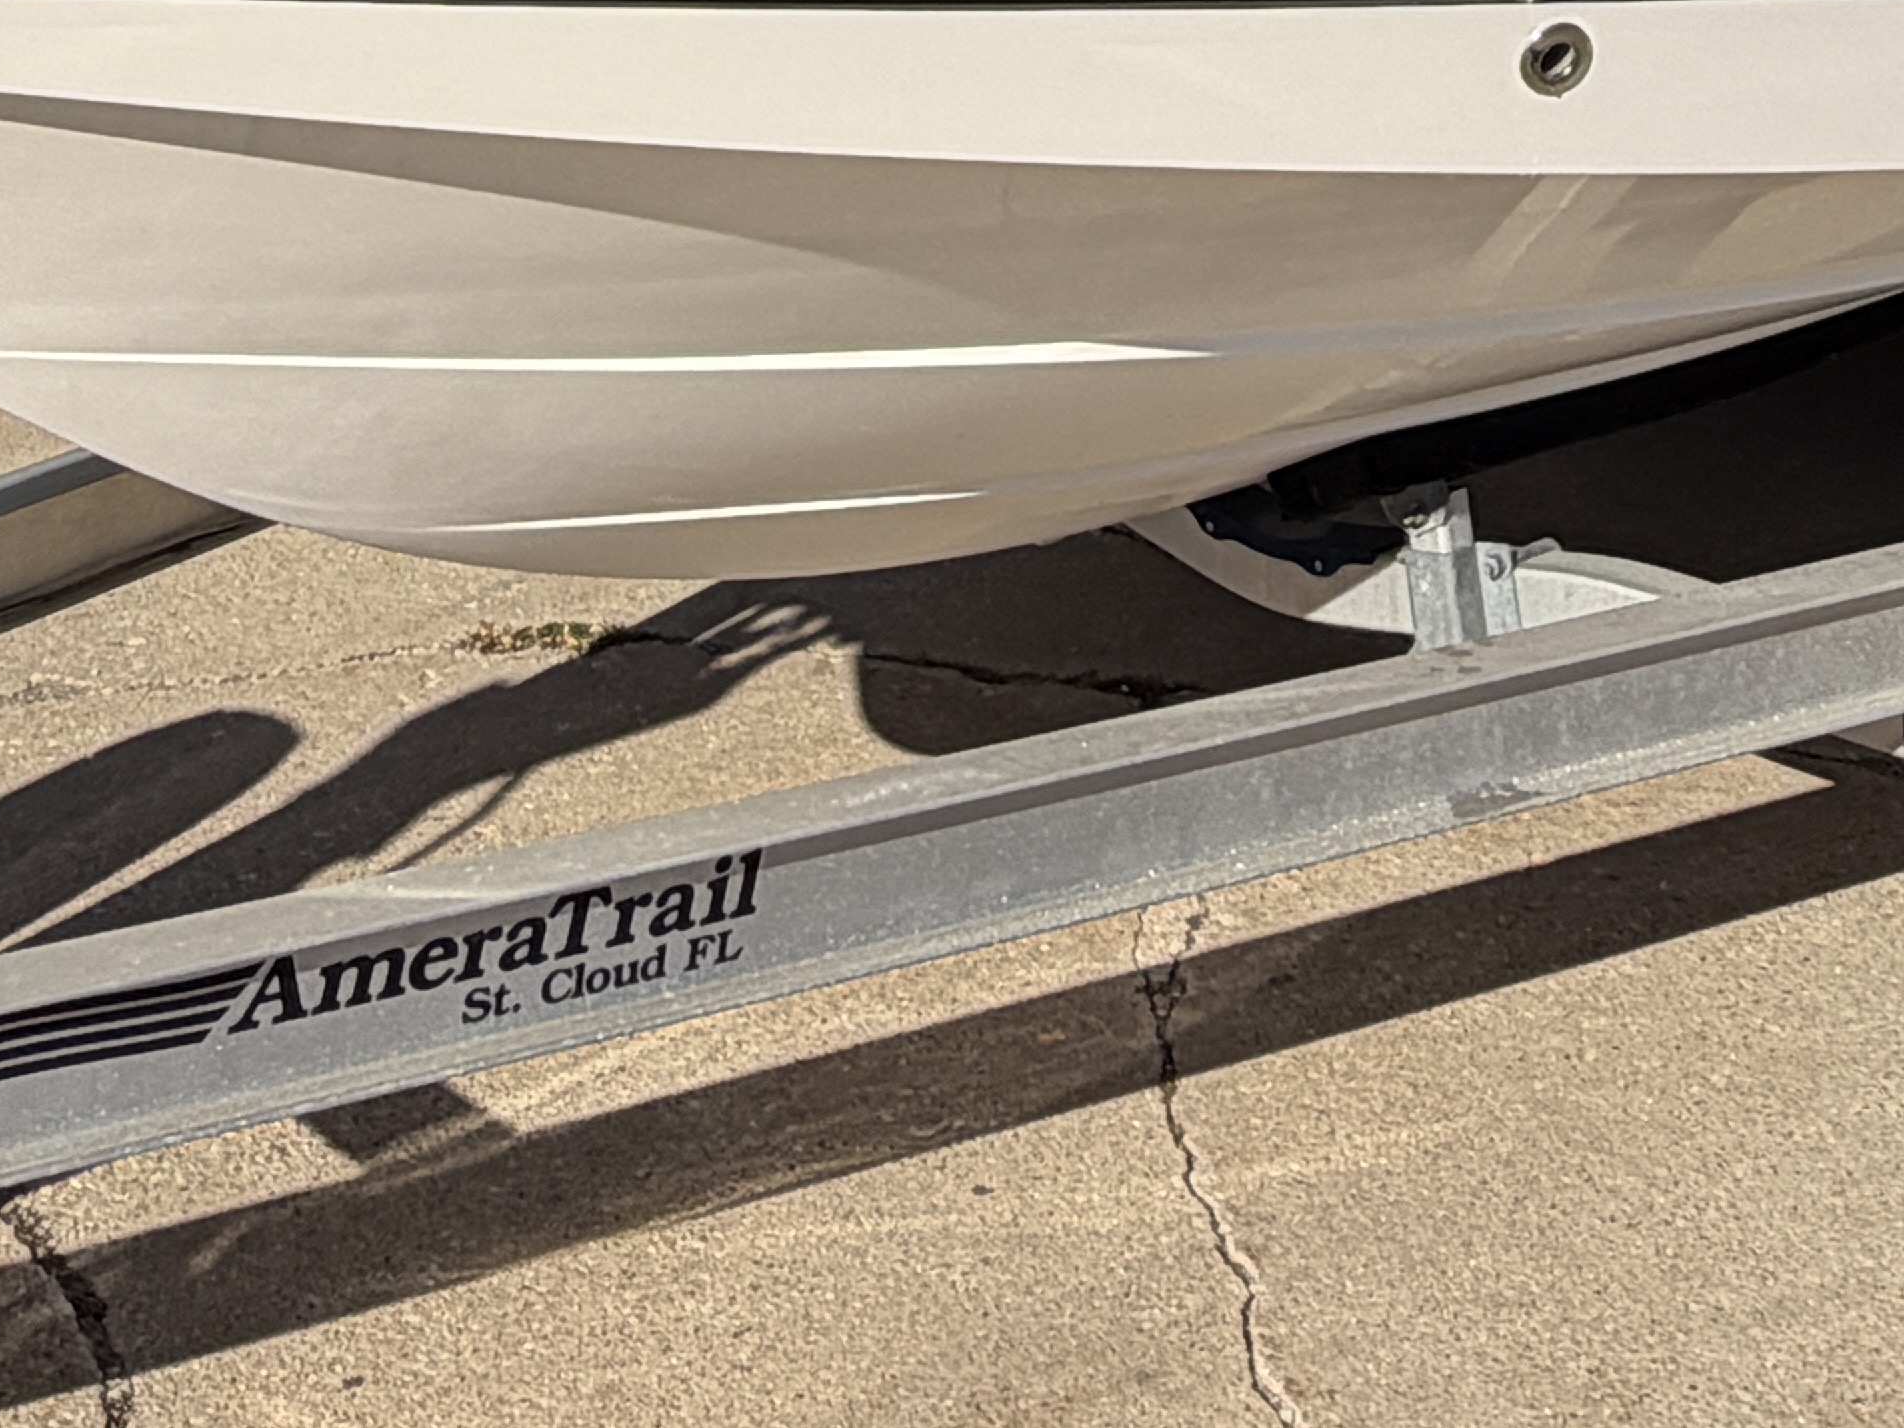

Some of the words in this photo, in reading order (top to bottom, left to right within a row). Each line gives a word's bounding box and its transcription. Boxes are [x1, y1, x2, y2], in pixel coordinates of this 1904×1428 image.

[226, 847, 765, 1037] AmeraTrail
[461, 983, 522, 1025] St.
[540, 952, 667, 1005] Cloud
[682, 928, 746, 973] FL
